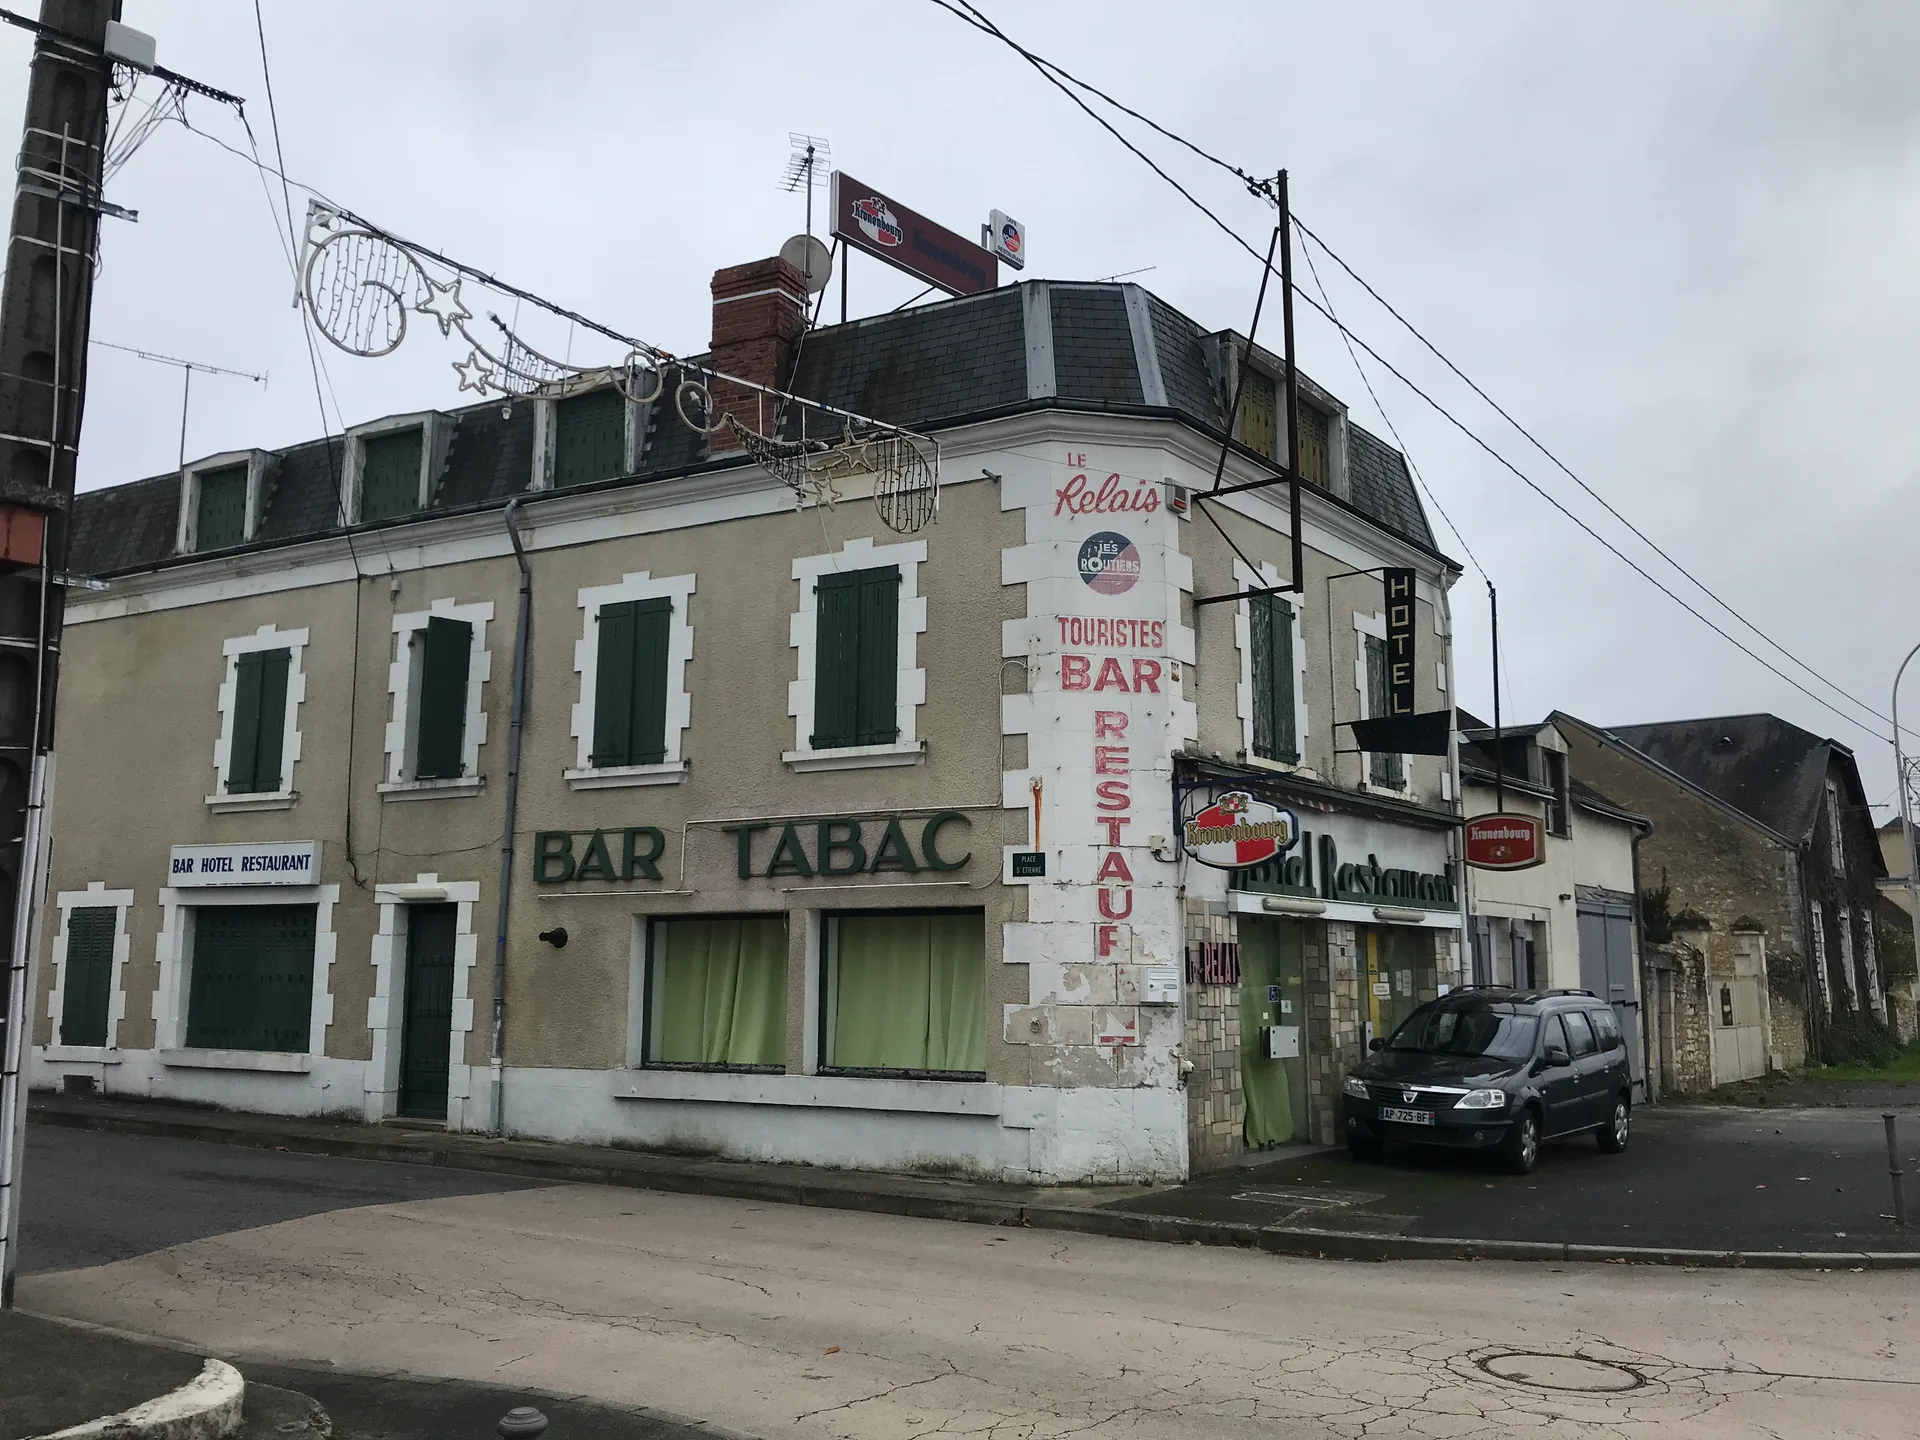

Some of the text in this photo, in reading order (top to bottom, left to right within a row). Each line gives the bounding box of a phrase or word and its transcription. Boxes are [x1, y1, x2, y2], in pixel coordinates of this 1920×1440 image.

[854, 201, 902, 243] Kronenbourg
[1067, 453, 1087, 468] LE
[1054, 473, 1162, 517] Relais
[1100, 543, 1119, 554] LES
[1081, 557, 1139, 573] ROUTIERS
[1057, 616, 1163, 648] TOURISTES
[1391, 576, 1411, 714] HOTEL
[1061, 655, 1162, 694] BAR
[533, 811, 972, 883] BAR TABAC
[1185, 818, 1288, 847] Kronenbourg
[1470, 826, 1531, 842] Kronenbourg
[172, 854, 311, 873] BAR HOTEL RESTAURANT
[1021, 855, 1036, 863] PLACE
